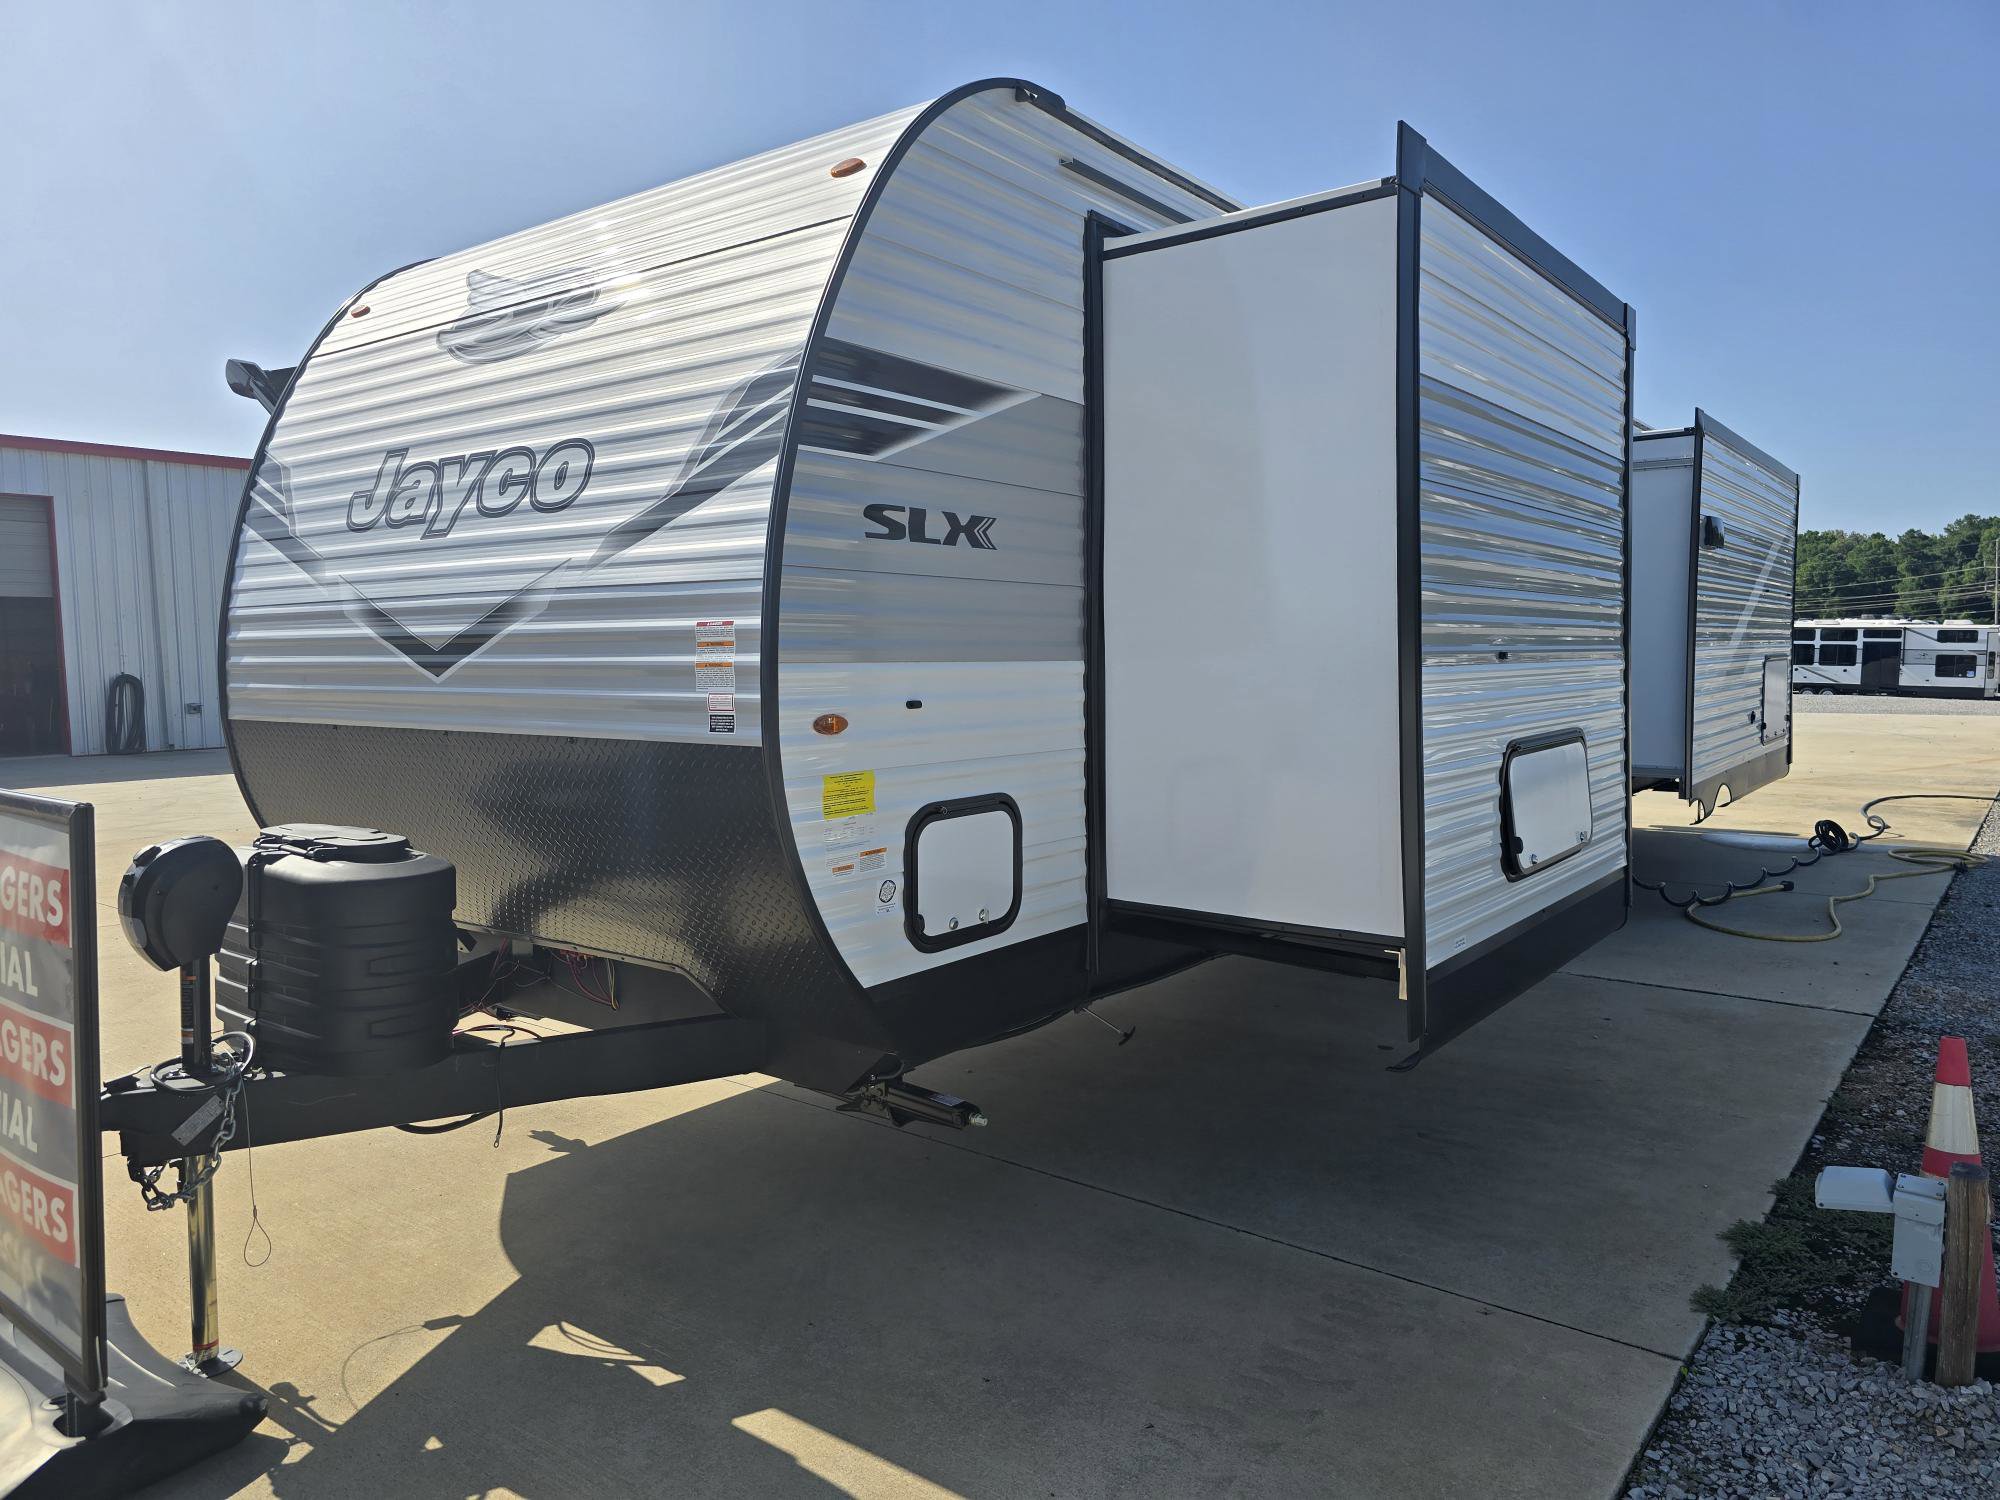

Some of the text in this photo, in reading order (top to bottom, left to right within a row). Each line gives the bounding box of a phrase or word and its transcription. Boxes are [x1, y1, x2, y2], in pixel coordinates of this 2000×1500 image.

[346, 438, 595, 540] Jayco
[863, 503, 998, 550] SLX
[0, 1018, 66, 1087] GERS
[0, 1091, 39, 1153] IAL
